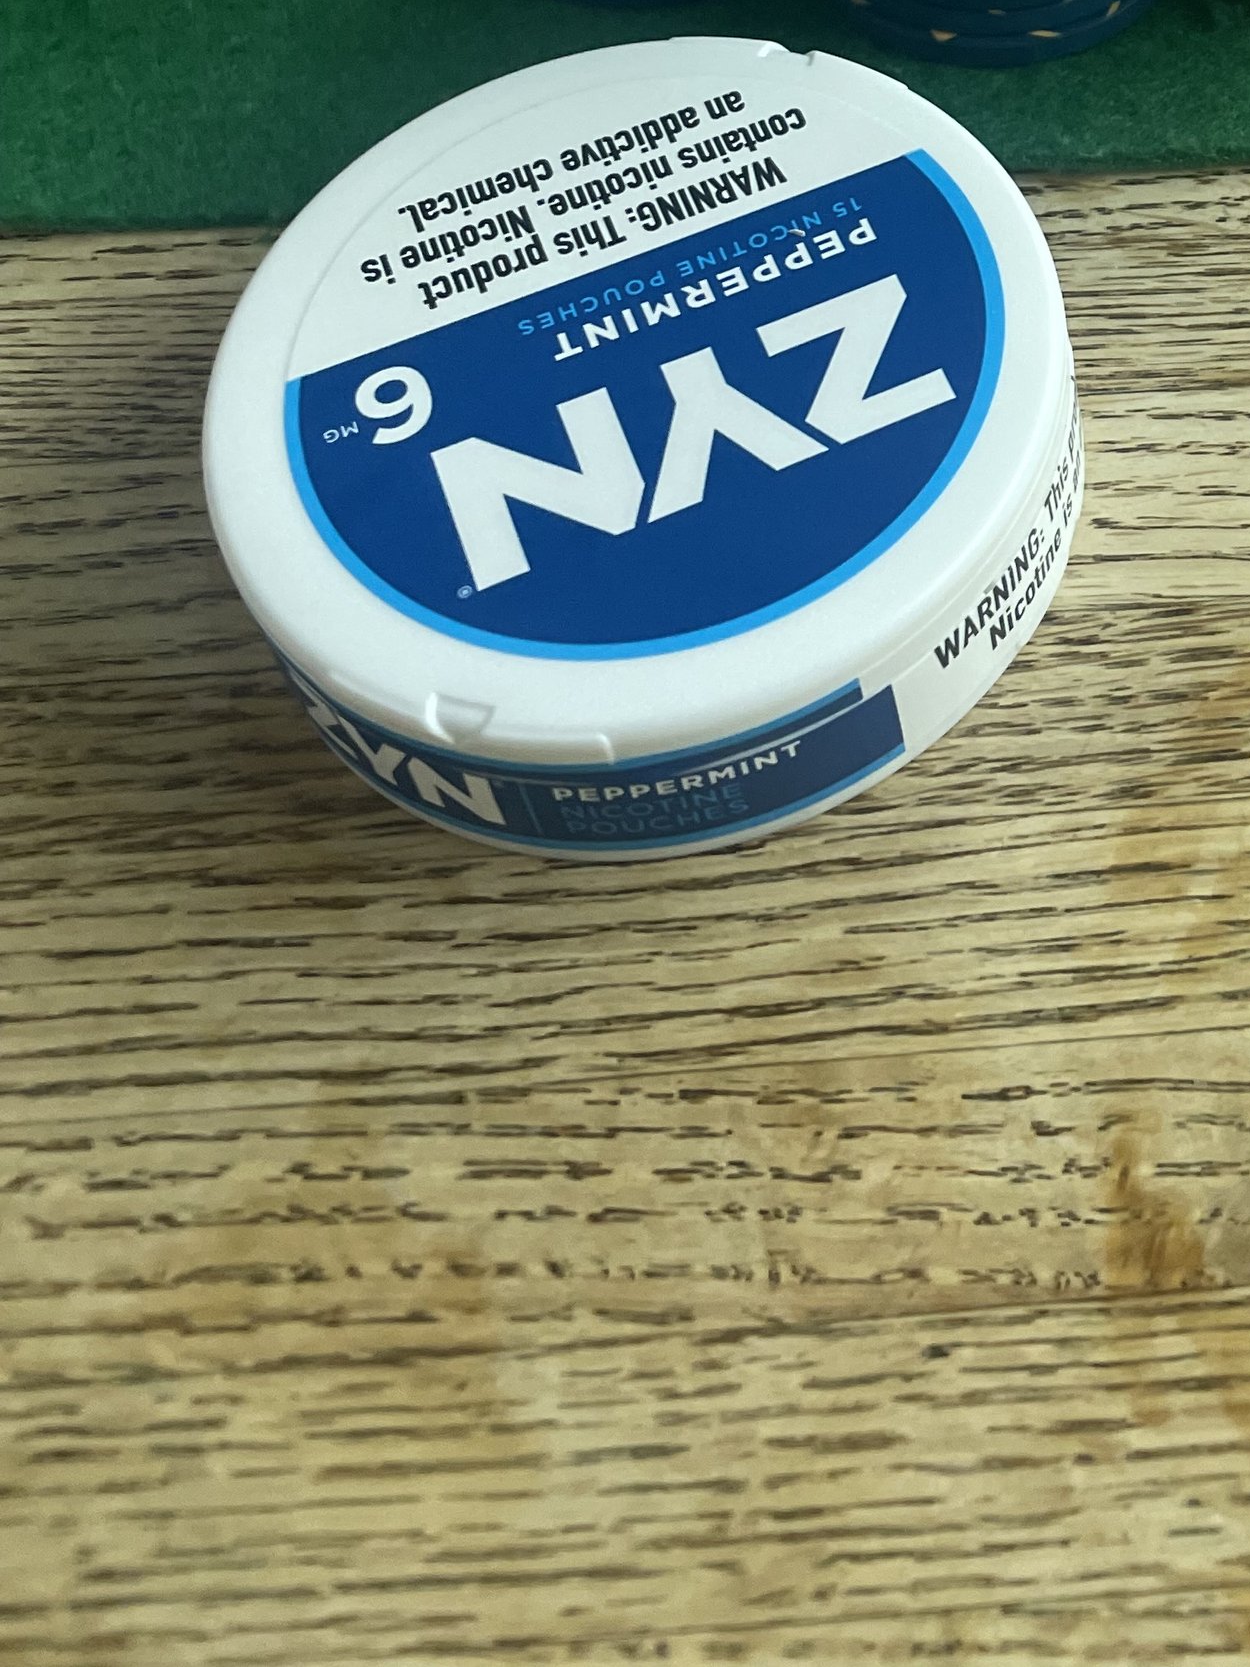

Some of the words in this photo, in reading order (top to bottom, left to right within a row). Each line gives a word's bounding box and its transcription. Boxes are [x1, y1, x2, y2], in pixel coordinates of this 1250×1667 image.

[703, 90, 746, 120] an
[560, 106, 701, 171] addictive
[677, 107, 807, 169] contains
[397, 158, 554, 234] chemical.
[536, 155, 675, 216] nicotine.
[624, 156, 788, 232] WARNING:
[832, 196, 863, 218] 15
[399, 205, 536, 269] Nicotine
[552, 215, 627, 258] This
[675, 210, 822, 278] NICOTINE
[360, 254, 397, 285] is
[417, 233, 549, 311] product
[553, 217, 879, 362] PEPPERMINT
[517, 270, 666, 336] POUCHES
[322, 421, 360, 444] MG
[354, 365, 433, 445] 6
[429, 272, 958, 593] ZYN
[933, 527, 1045, 669] WARNING:
[1043, 456, 1069, 522] This
[988, 527, 1062, 651] Nicotine
[1062, 492, 1073, 527] is
[551, 740, 801, 802] PEPPERMINT
[560, 784, 743, 820] NICOTINE
[566, 799, 749, 835] POUCHES
